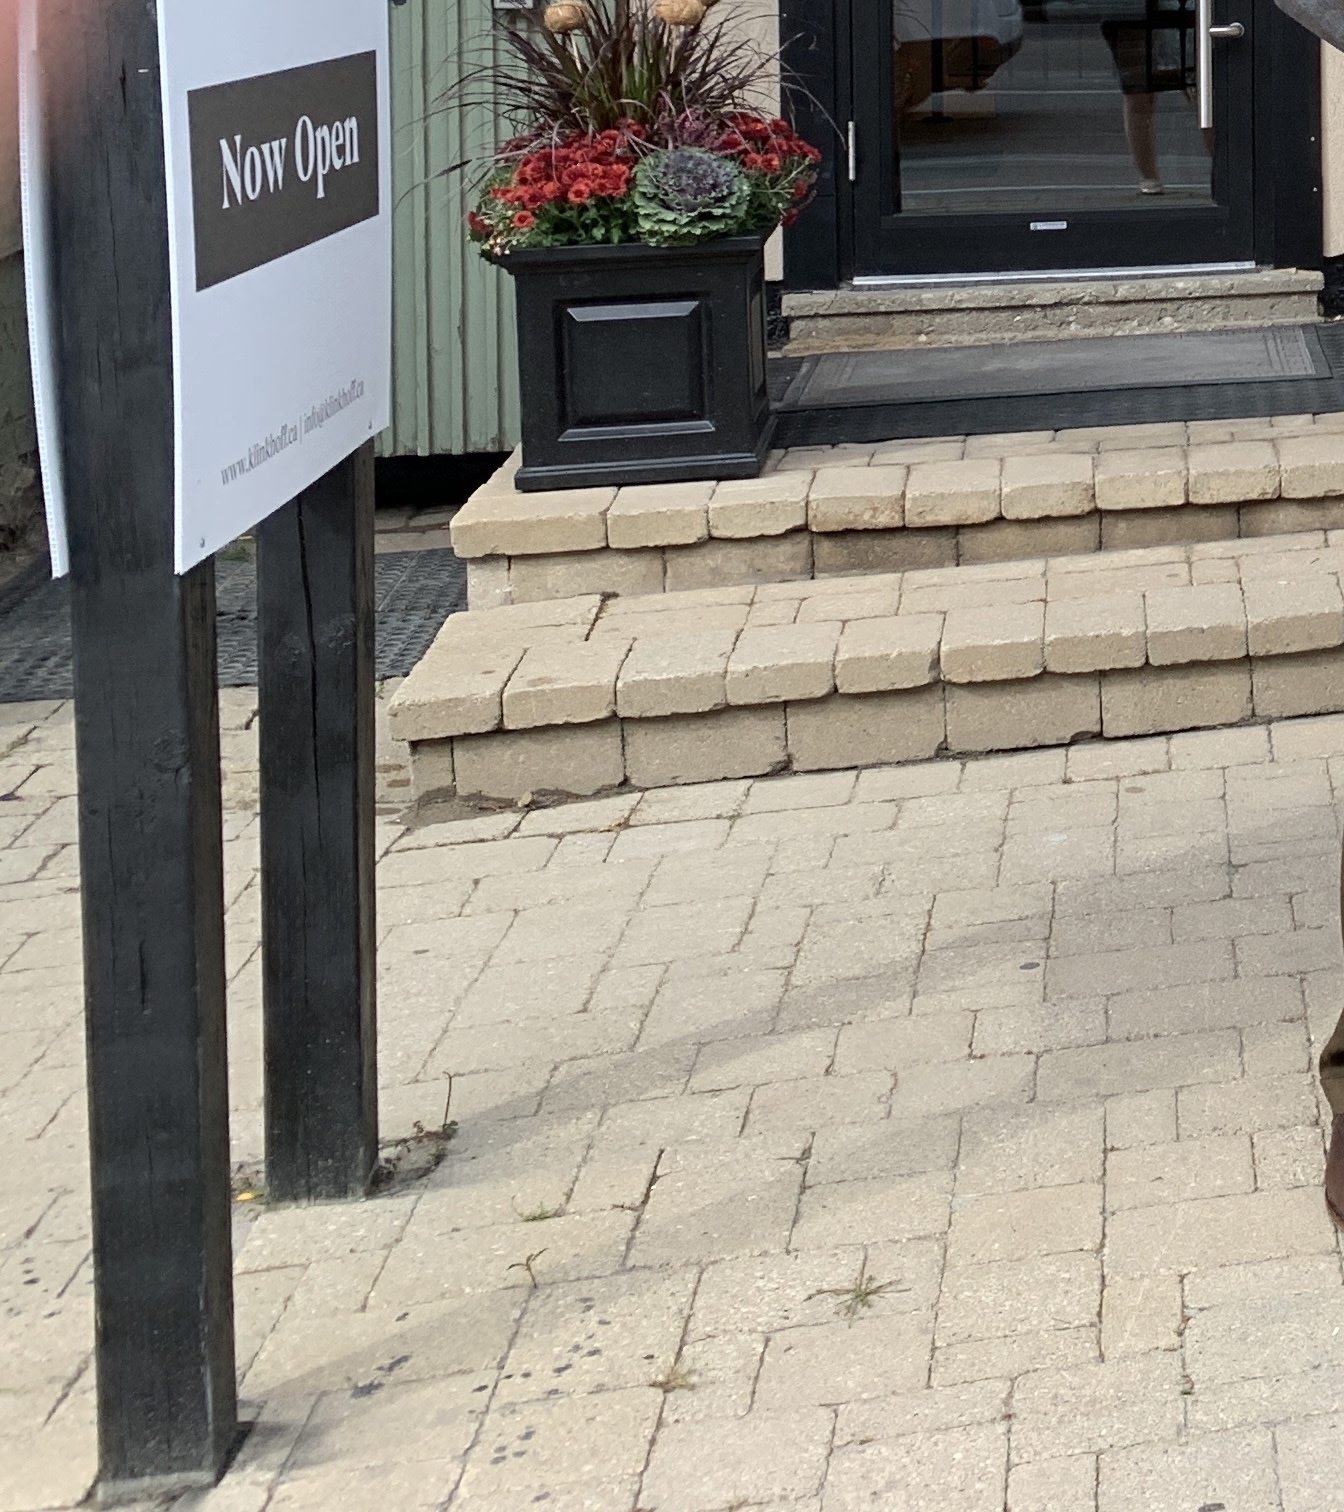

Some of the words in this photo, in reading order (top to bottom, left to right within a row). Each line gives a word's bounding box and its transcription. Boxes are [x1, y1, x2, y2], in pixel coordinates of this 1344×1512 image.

[219, 134, 287, 210] Now
[294, 115, 360, 199] Open
[220, 423, 298, 486] www.klinkhoff.ca
